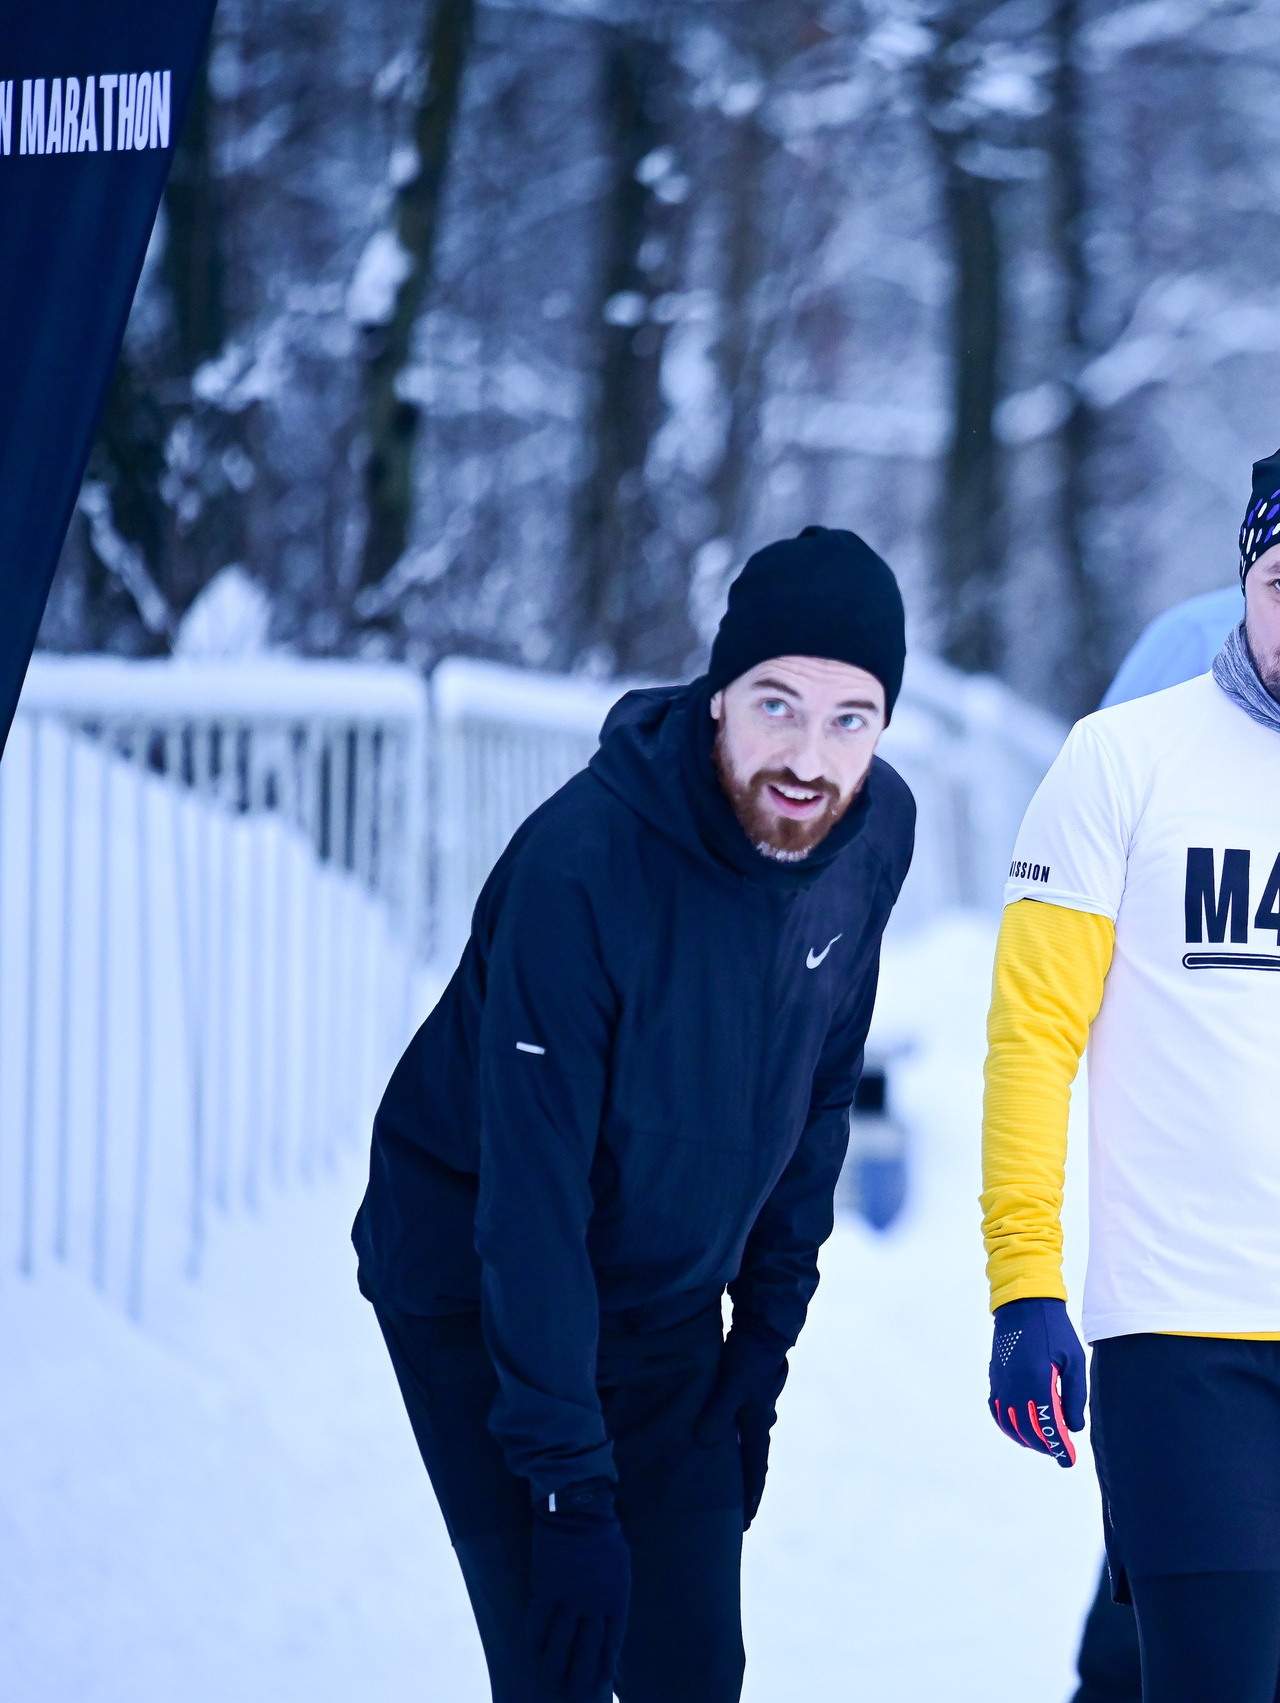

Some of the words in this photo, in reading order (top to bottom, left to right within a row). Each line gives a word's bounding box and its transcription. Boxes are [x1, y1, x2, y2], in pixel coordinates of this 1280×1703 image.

[20, 70, 171, 154] MARATHON
[1009, 861, 1050, 883] ISSION
[1036, 1404, 1066, 1459] MOAX
